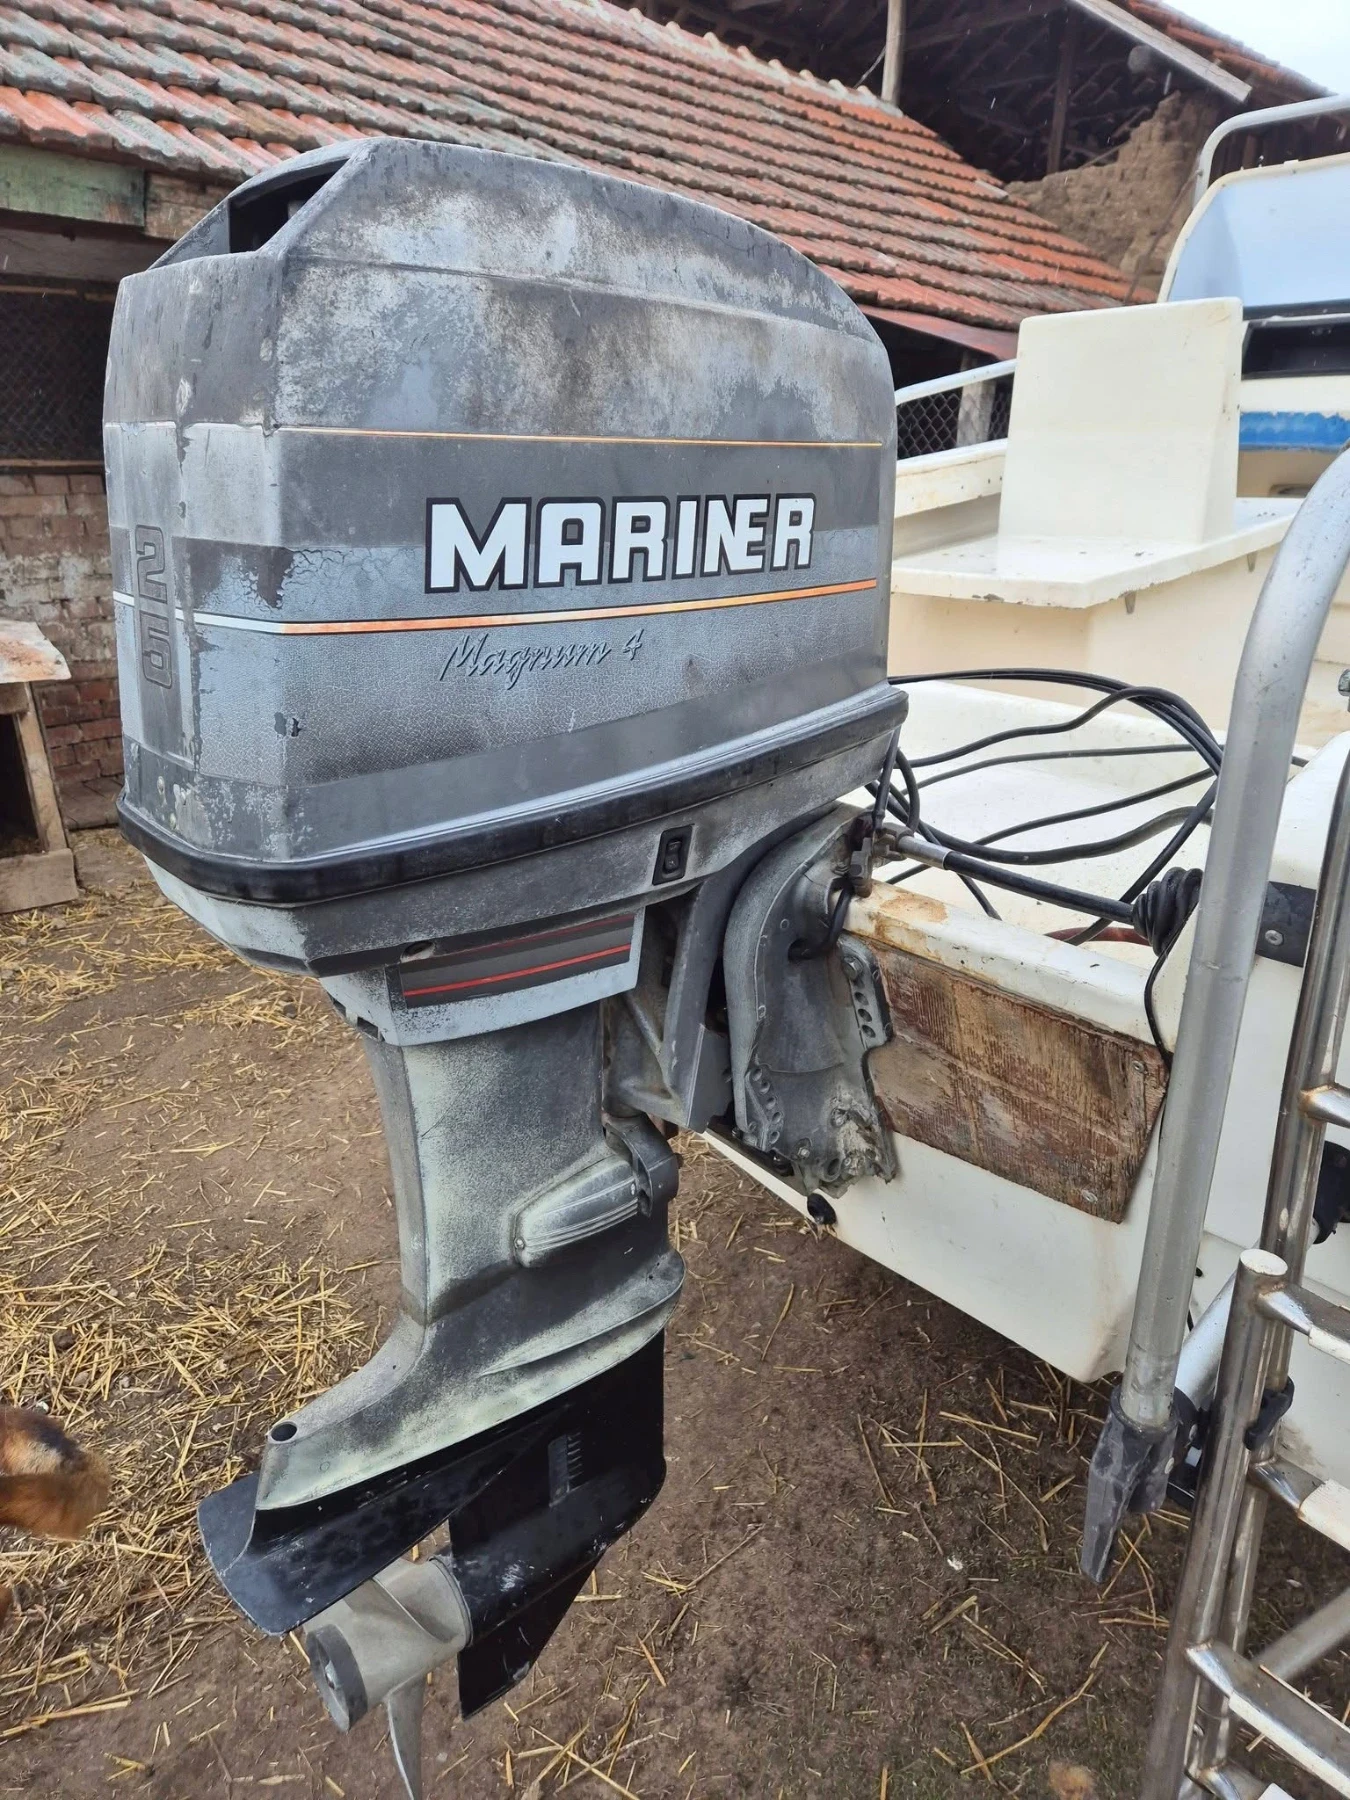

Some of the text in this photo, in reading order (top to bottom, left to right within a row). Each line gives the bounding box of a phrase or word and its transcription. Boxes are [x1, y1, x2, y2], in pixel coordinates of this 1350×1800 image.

[425, 493, 815, 594] MARINER
[440, 629, 645, 690] Magnum 4
